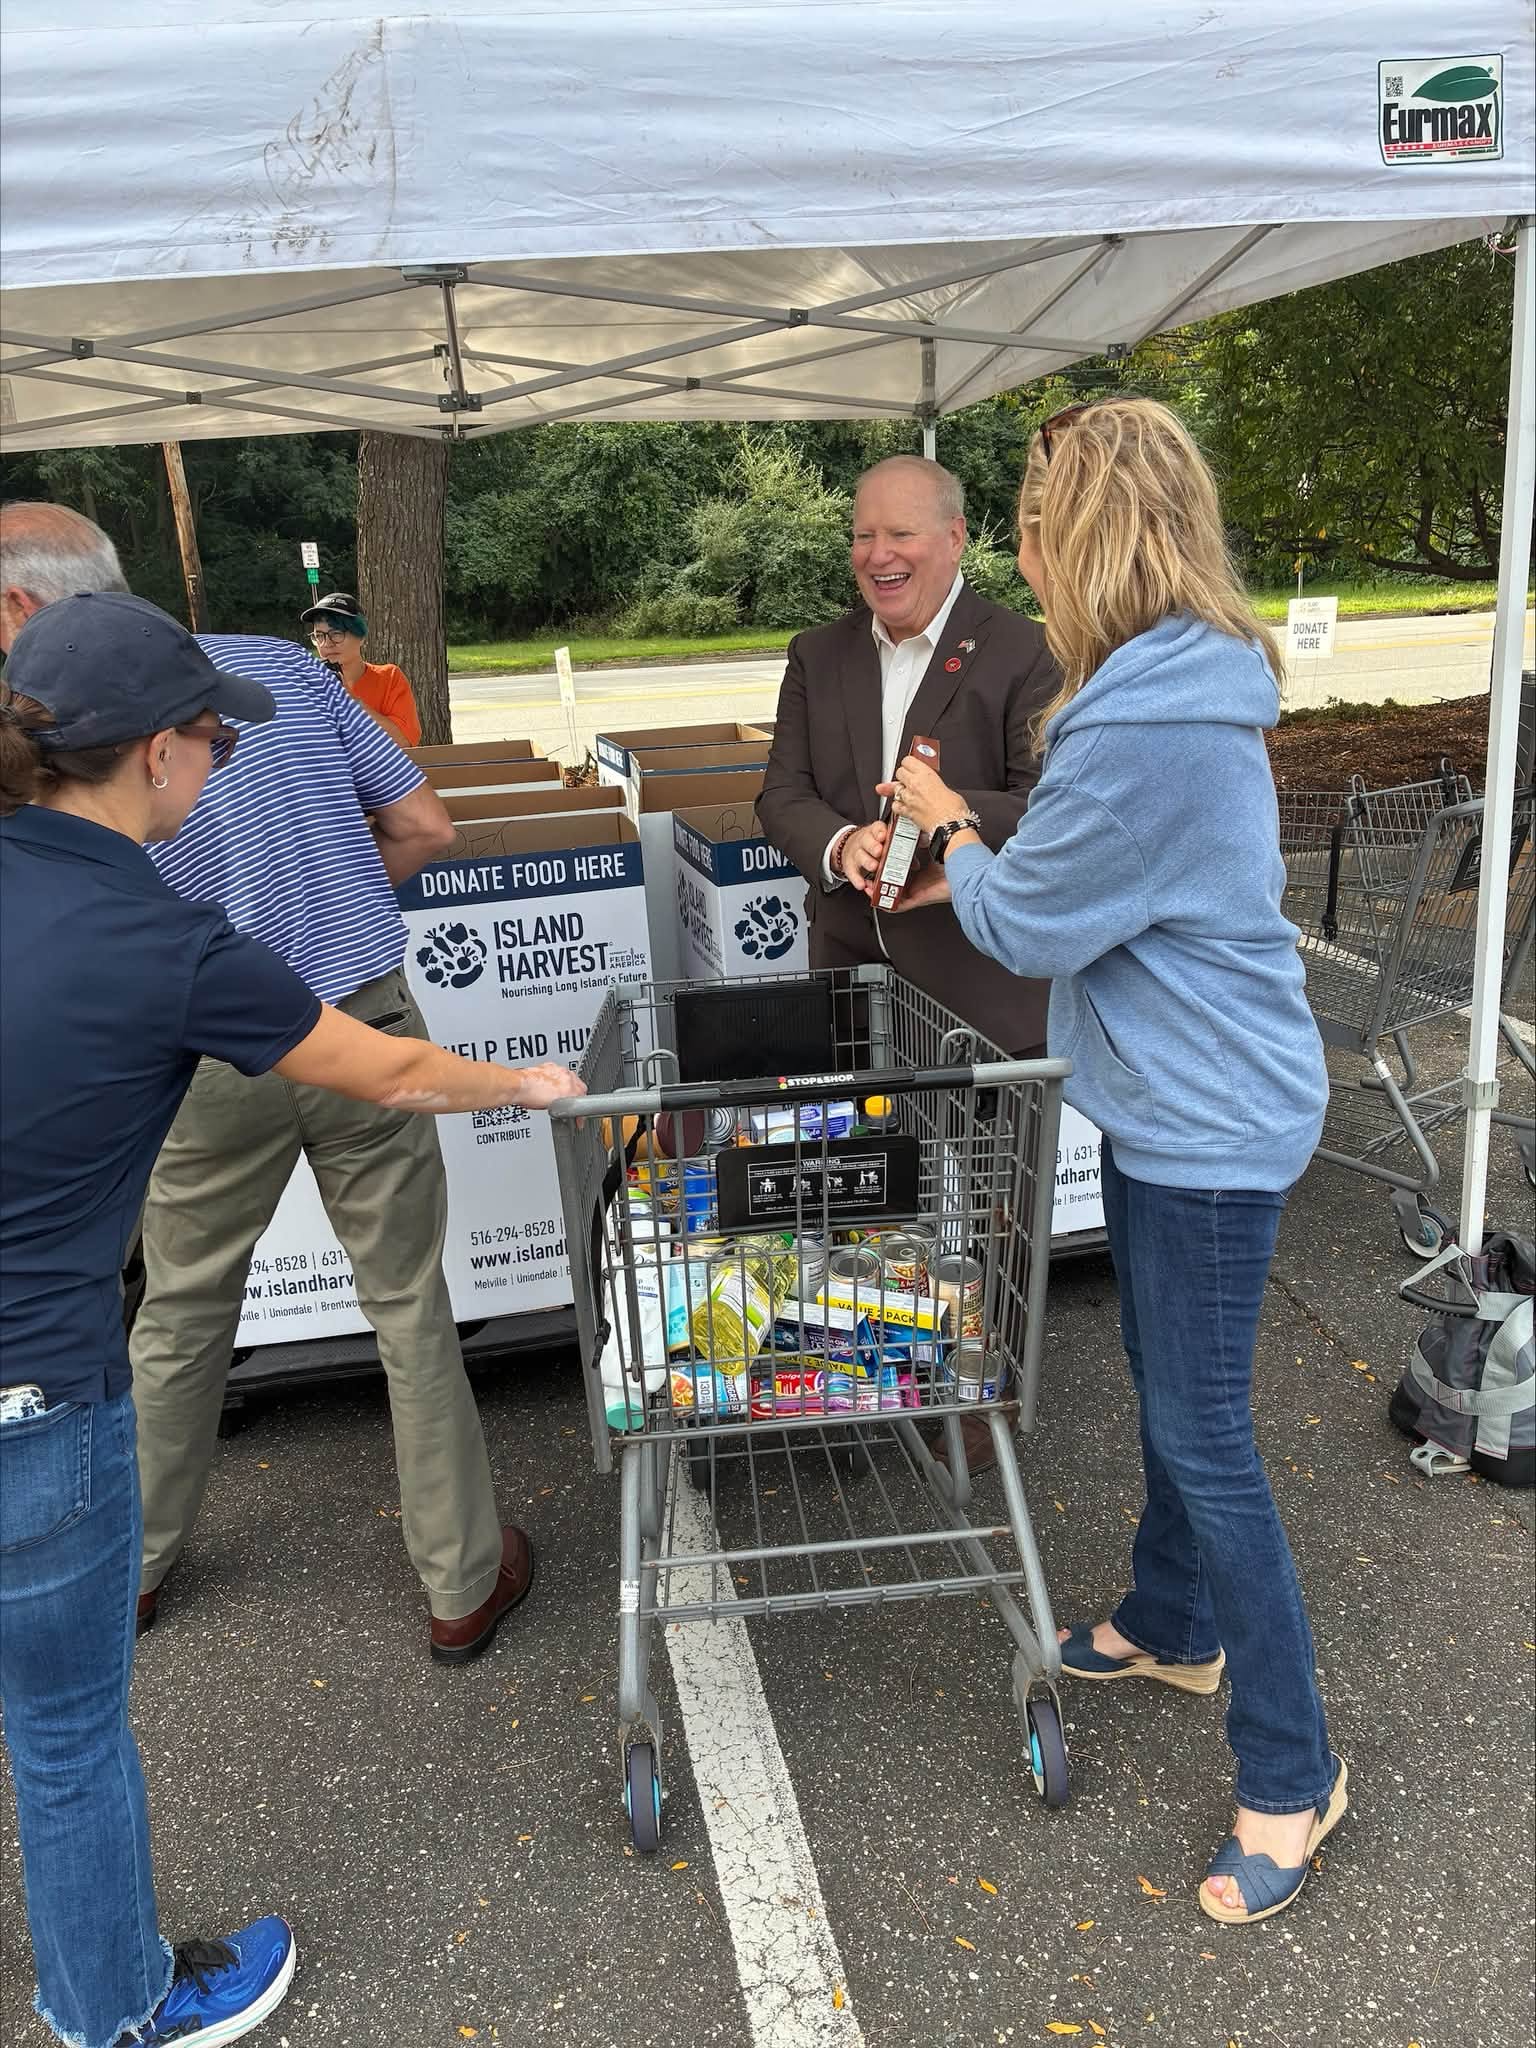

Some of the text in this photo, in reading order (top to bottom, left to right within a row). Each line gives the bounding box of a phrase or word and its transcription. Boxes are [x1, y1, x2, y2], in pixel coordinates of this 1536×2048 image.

[1383, 103, 1493, 145] Eurmax
[1293, 622, 1328, 634] DONATE
[1297, 637, 1320, 649] HERE
[420, 852, 626, 898] DONATE FOOD HERE
[493, 911, 584, 950] ISLAND
[497, 942, 609, 982] HARVEST
[609, 951, 646, 963] FEEDING
[609, 959, 646, 969] AMERICA
[501, 972, 648, 999] Nourishing Long Island's Future
[445, 1041, 497, 1062] ELP
[506, 1034, 547, 1060] END
[476, 1127, 531, 1145] CONTRIBUTE
[801, 1158, 841, 1169] WARING
[471, 1220, 555, 1246] 516-294-8528
[474, 1277, 508, 1291] Melville
[516, 1268, 558, 1284] Uniondale
[240, 1309, 260, 1322] ville
[269, 1303, 313, 1319] Uniondale
[838, 1302, 874, 1314] VAUE
[886, 1311, 916, 1324] PACK
[775, 1372, 815, 1381] Colgte
